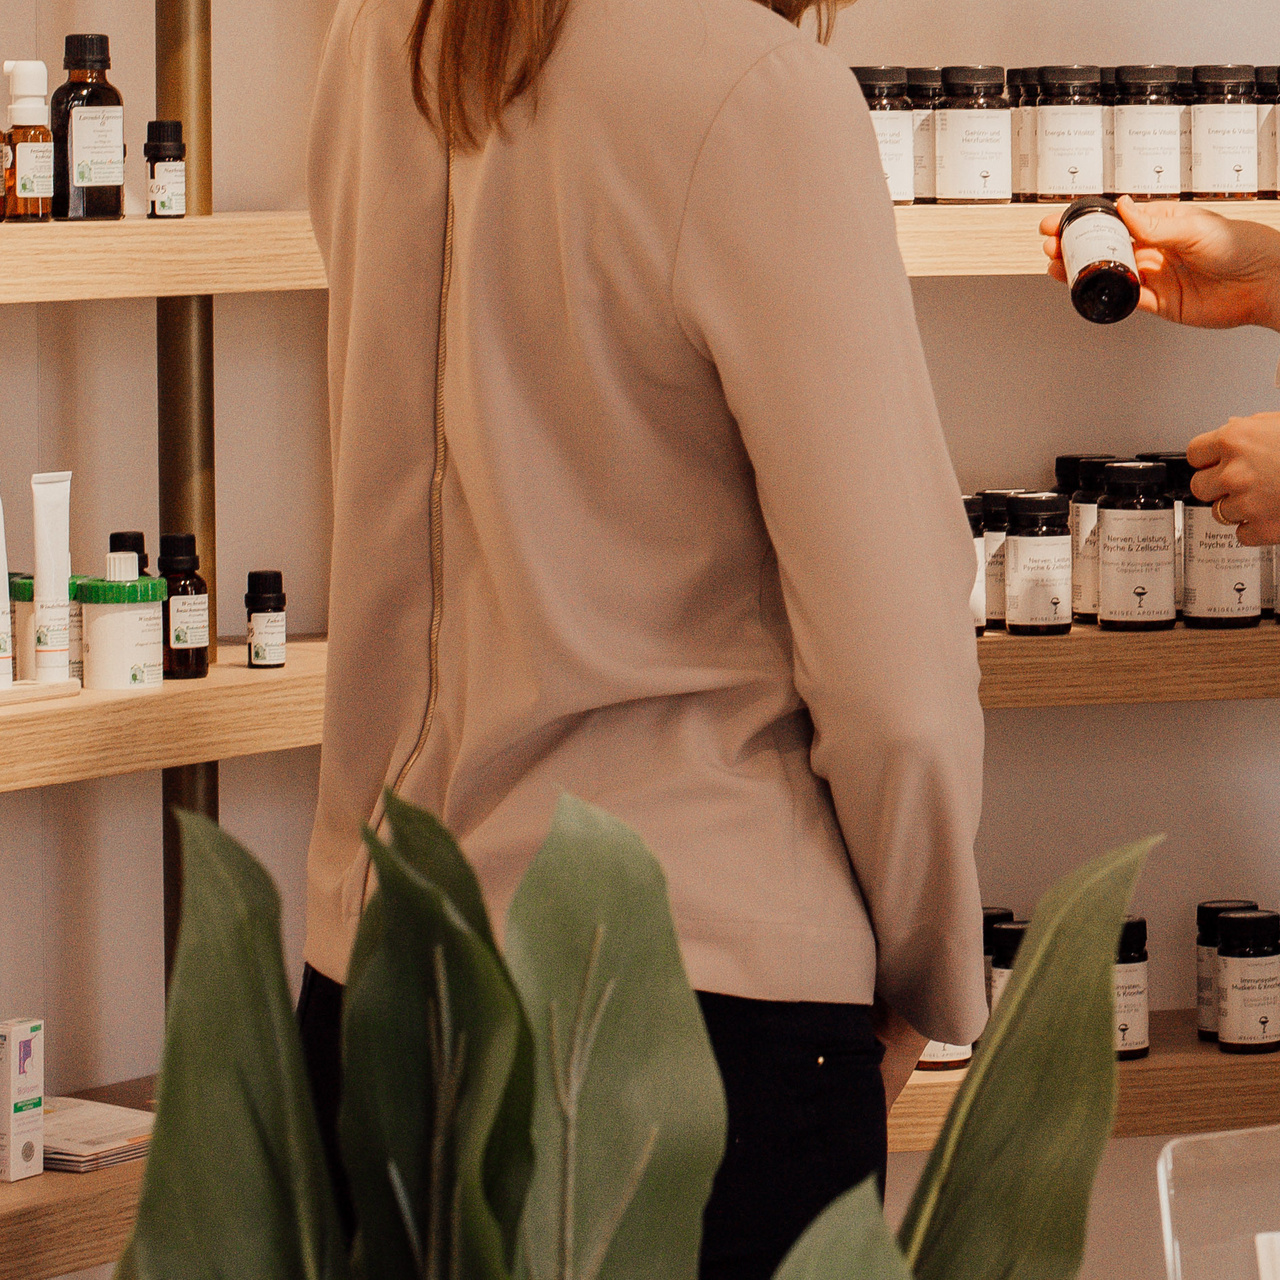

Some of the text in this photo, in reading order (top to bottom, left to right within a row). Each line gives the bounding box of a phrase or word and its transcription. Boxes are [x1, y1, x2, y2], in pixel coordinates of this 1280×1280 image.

[1204, 531, 1235, 541] Nerven,
[1128, 544, 1134, 552] &
[1199, 541, 1234, 551] Psyche &
